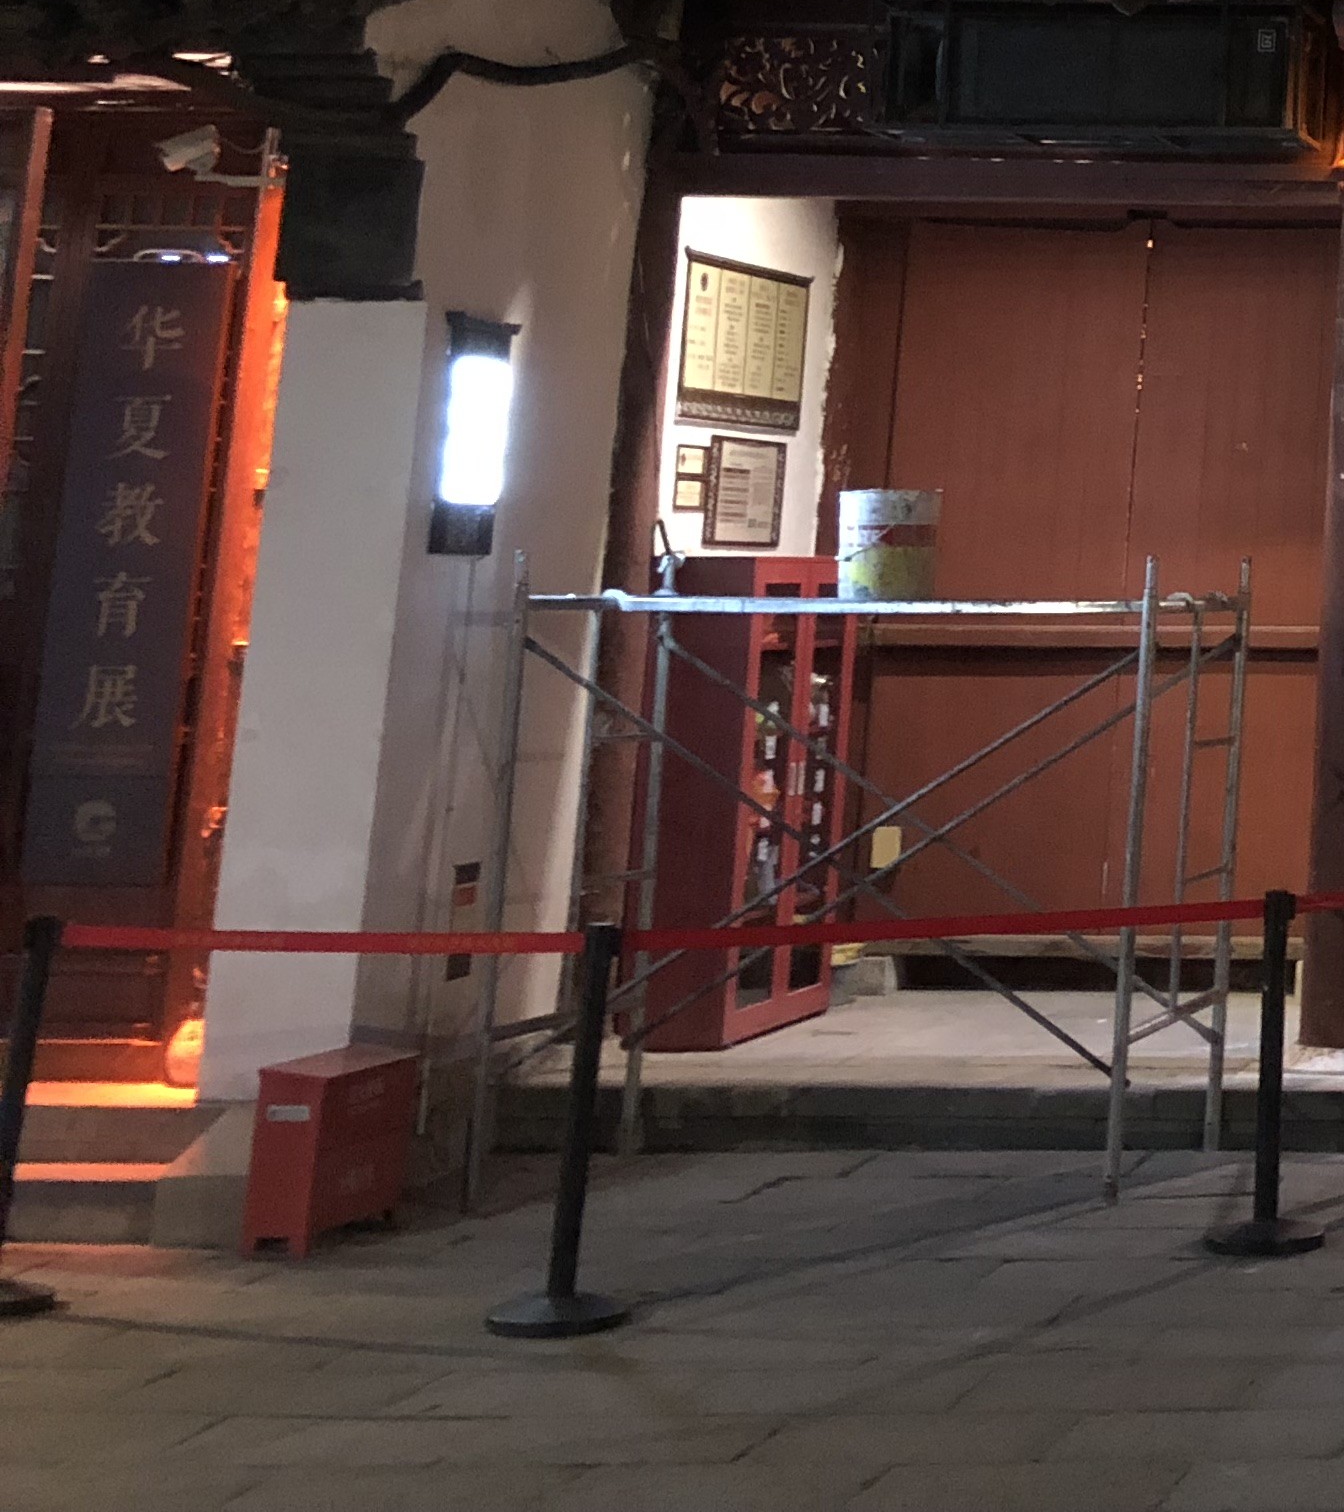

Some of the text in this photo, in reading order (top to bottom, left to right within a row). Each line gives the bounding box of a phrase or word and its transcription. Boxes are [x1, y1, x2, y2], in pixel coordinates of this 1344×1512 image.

[71, 303, 186, 729] 华夏教育展
